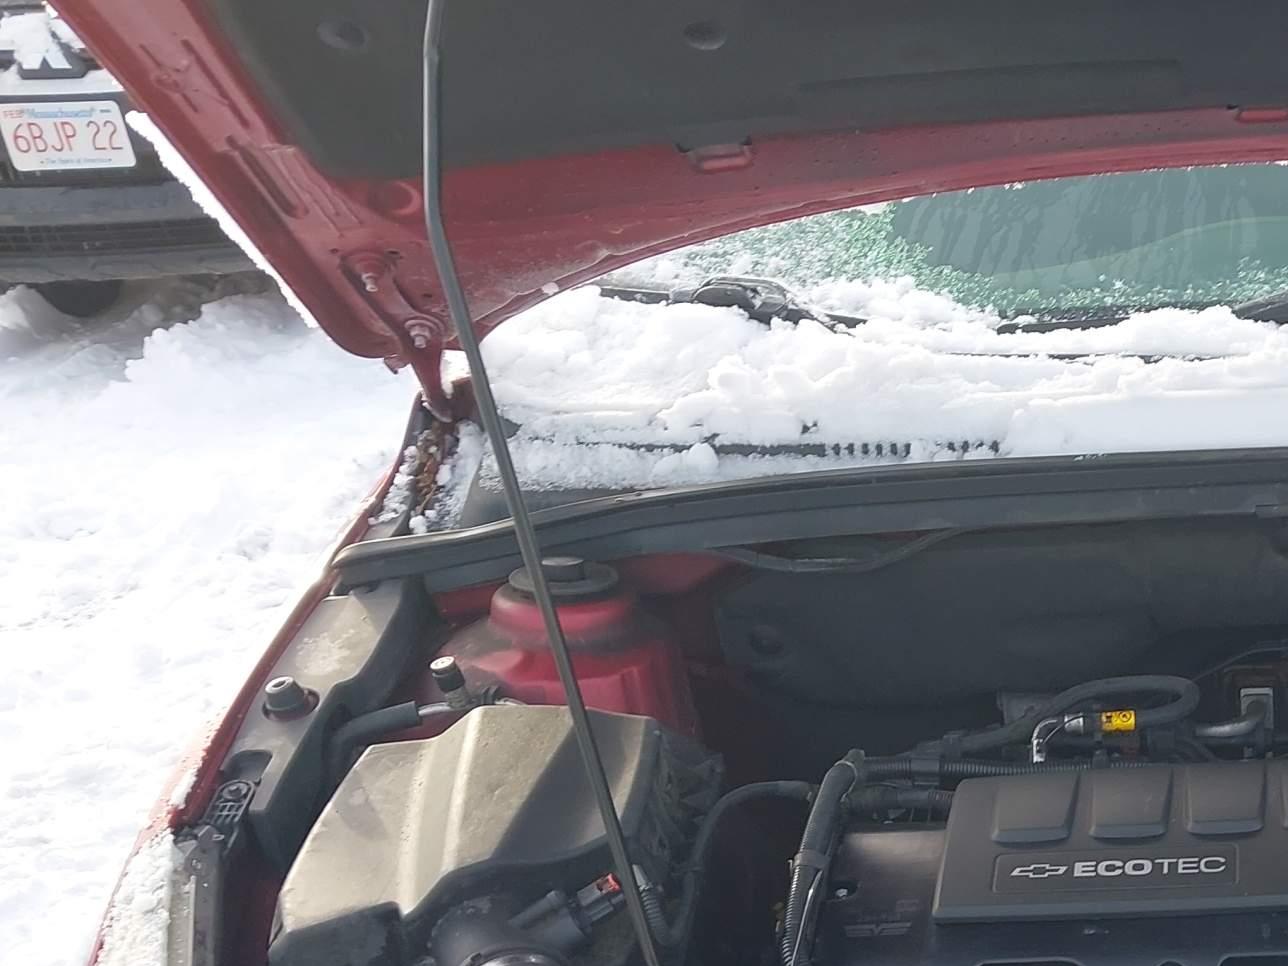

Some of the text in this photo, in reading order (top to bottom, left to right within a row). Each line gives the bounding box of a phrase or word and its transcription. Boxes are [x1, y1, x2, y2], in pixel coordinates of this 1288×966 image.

[13, 120, 123, 153] 6BJP 22
[1073, 856, 1226, 878] ECOTEC
